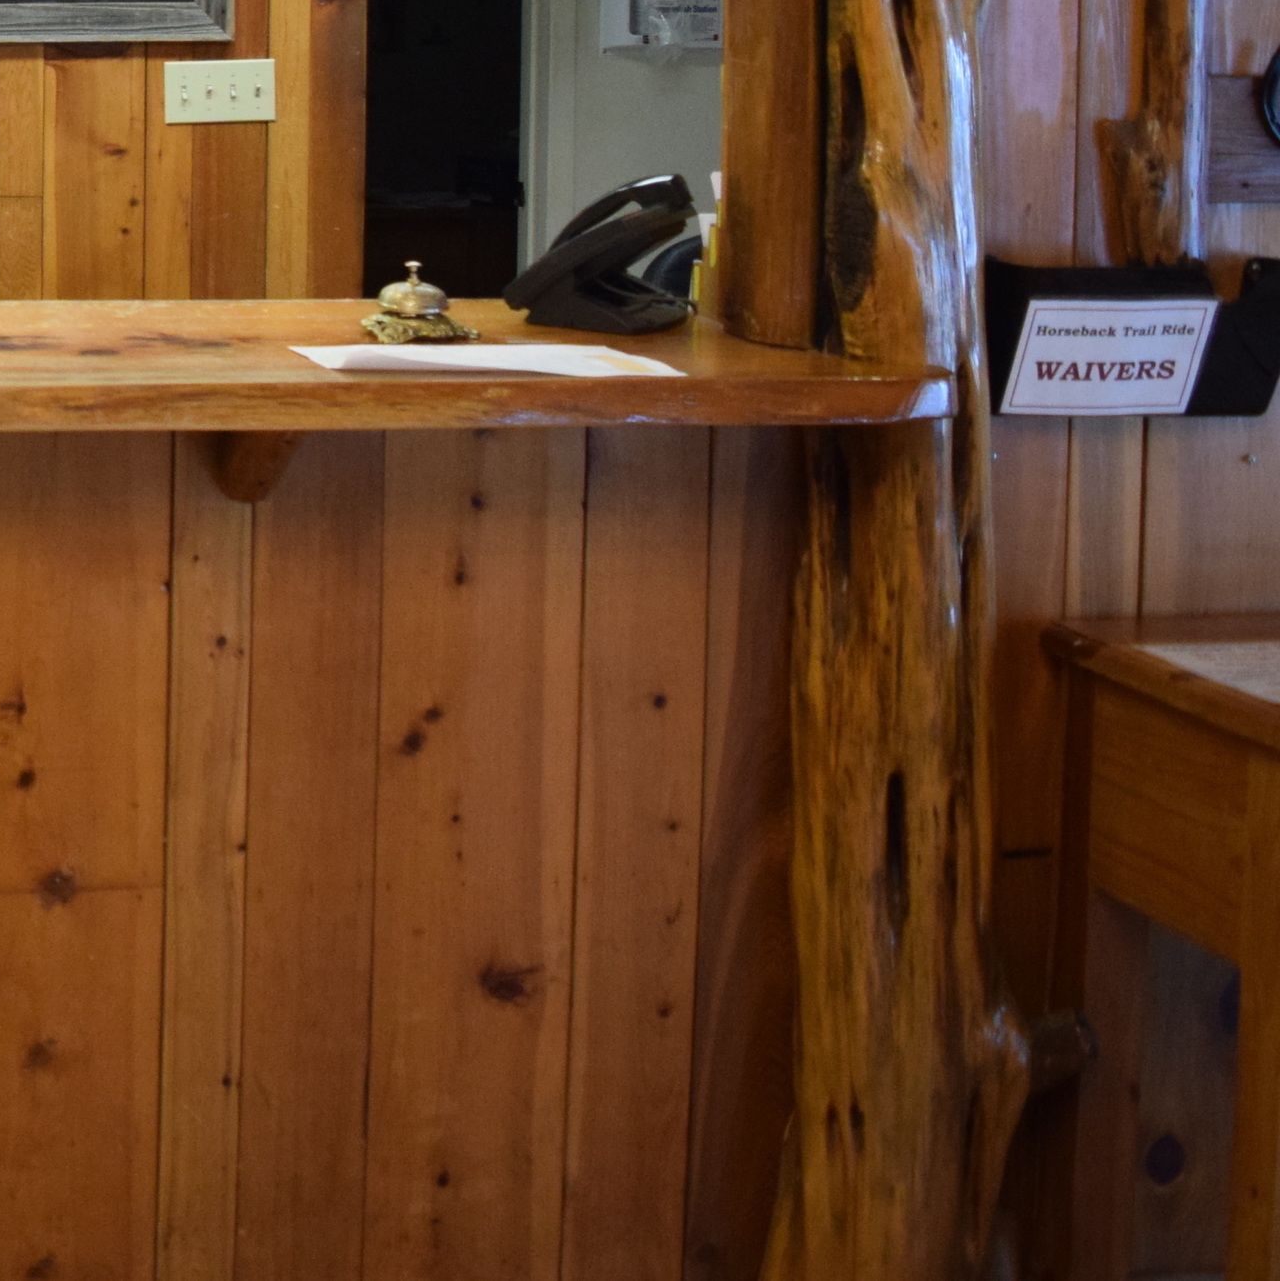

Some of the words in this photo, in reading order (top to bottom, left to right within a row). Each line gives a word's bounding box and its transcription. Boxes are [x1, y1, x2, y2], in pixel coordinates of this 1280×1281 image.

[1036, 325, 1116, 337] Horseback
[1123, 325, 1156, 337] Trail
[1162, 324, 1195, 336] Ride
[1035, 360, 1175, 382] WAIVERS
